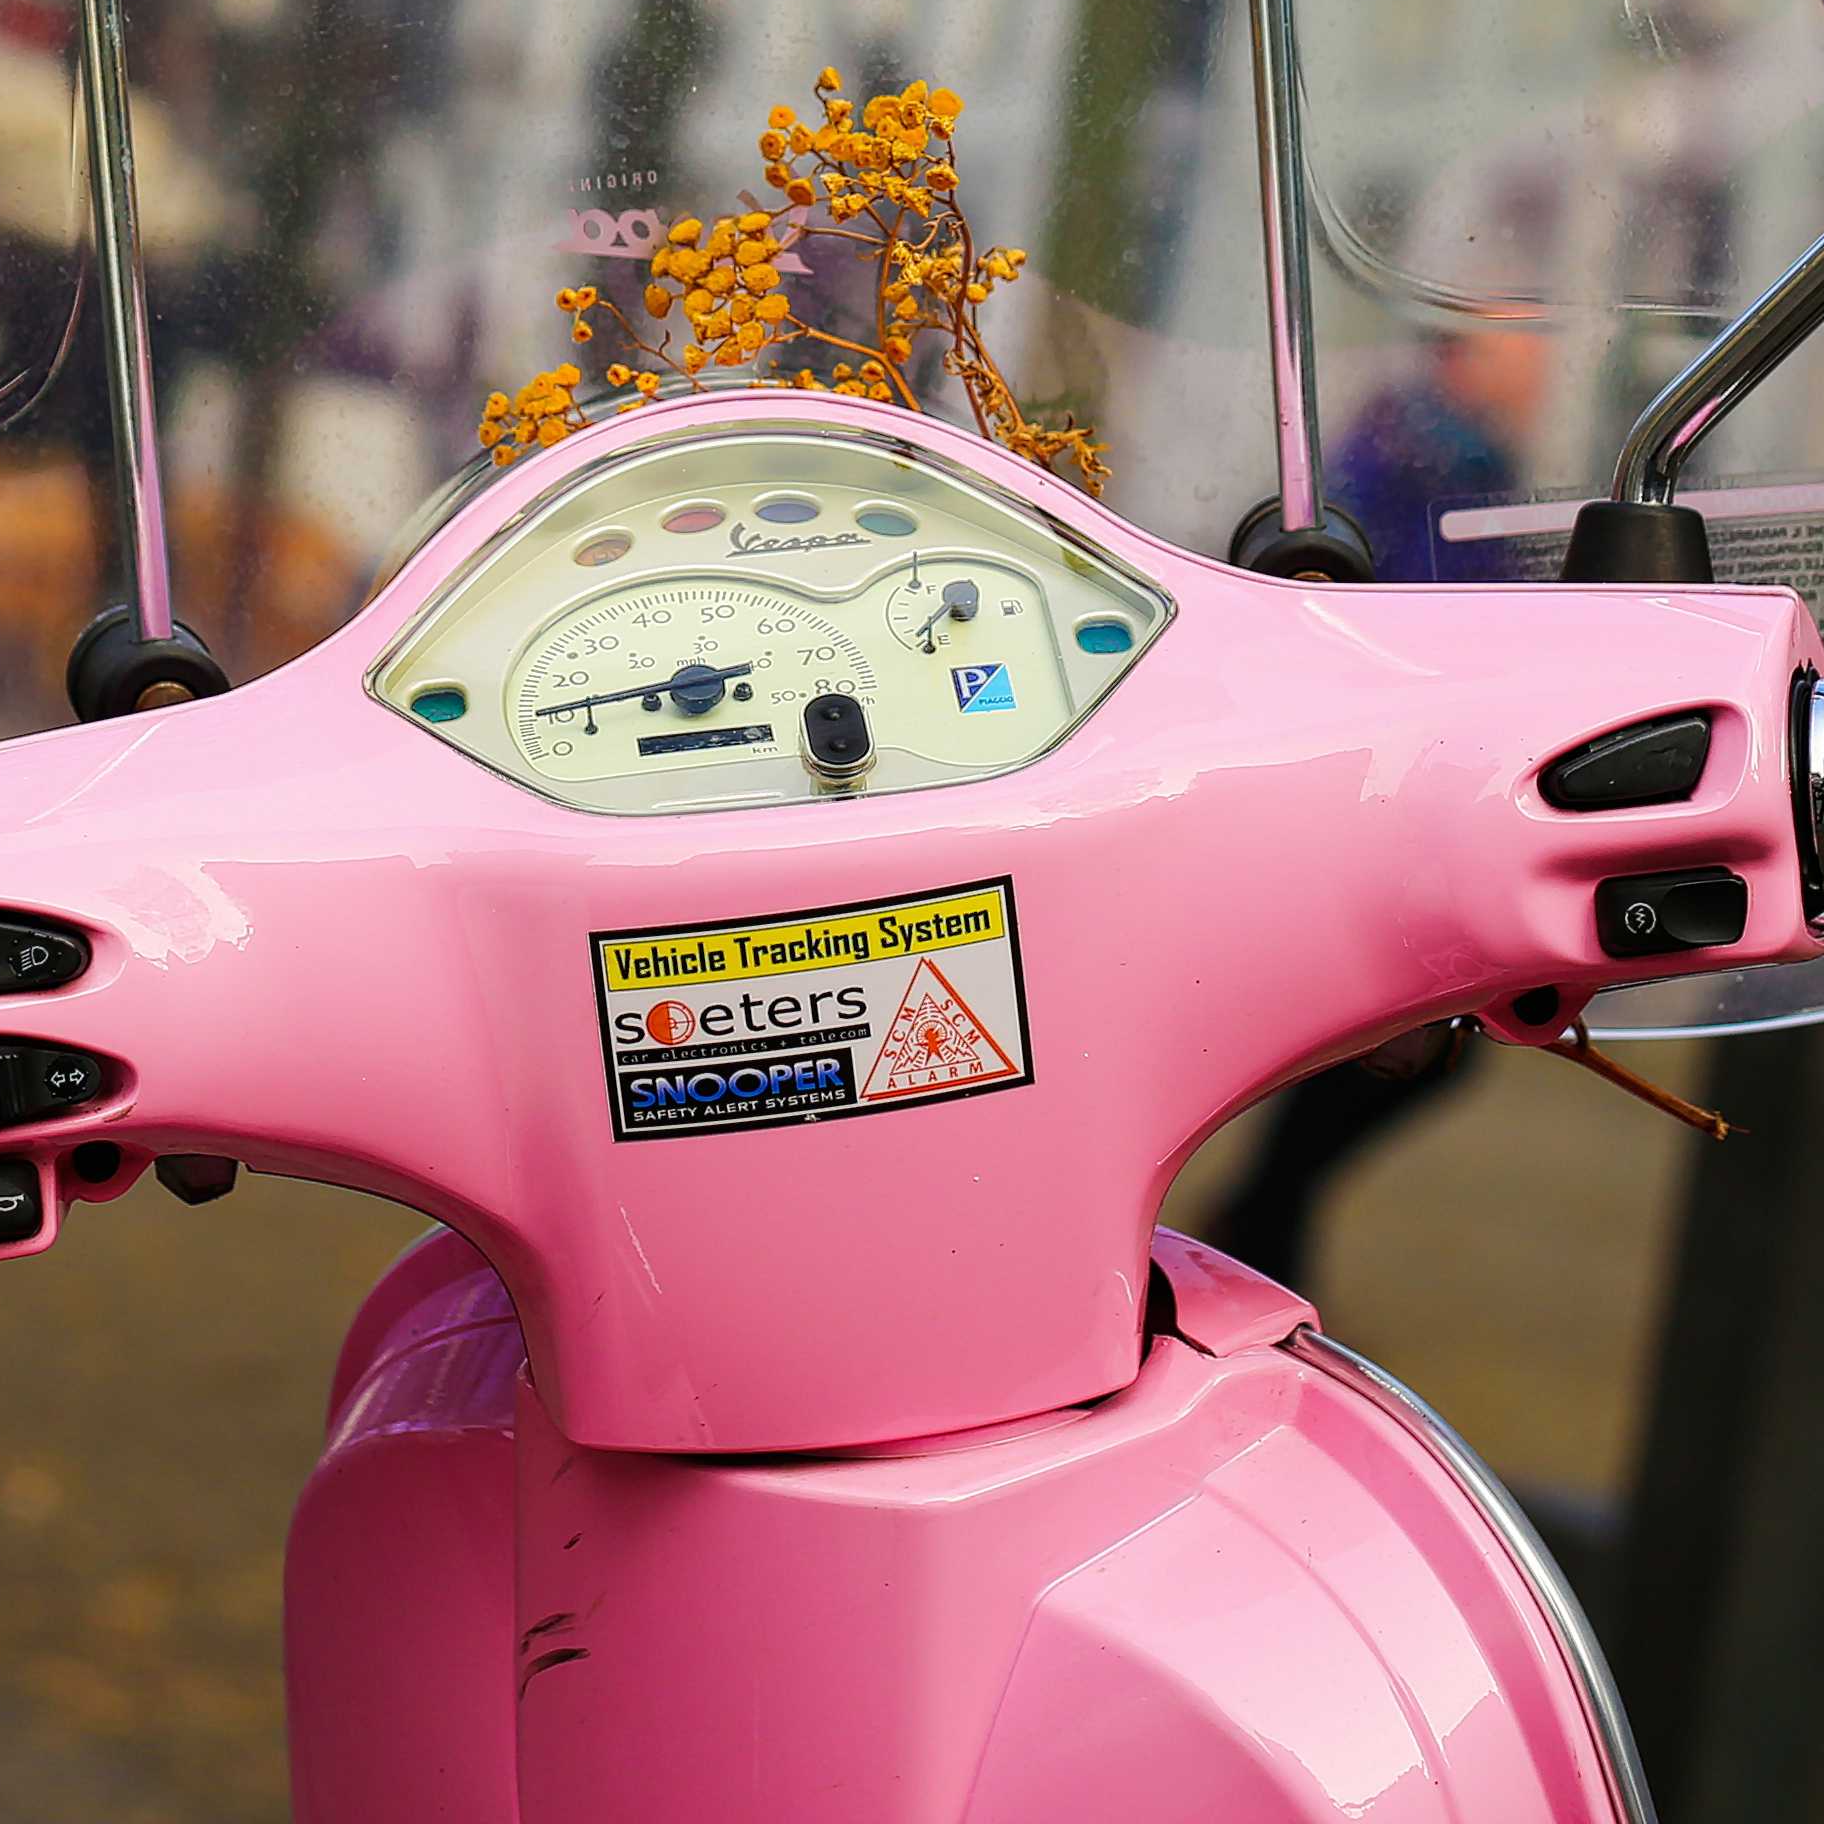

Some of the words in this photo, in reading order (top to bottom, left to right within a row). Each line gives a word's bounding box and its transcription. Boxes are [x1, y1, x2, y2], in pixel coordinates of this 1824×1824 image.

[726, 522, 872, 558] Vespa
[927, 584, 937, 594] F
[631, 610, 672, 628] 40
[700, 605, 735, 623] 50
[757, 618, 796, 635] 60
[583, 635, 619, 655] 30
[693, 640, 718, 655] 30
[937, 634, 951, 645] E
[628, 657, 655, 669] 20
[796, 646, 836, 665] 70
[552, 671, 589, 688] 20
[815, 678, 856, 695] 80
[771, 690, 796, 705] 50
[553, 741, 573, 756] 0
[752, 745, 778, 755] km
[614, 941, 726, 980] Vehicle
[733, 929, 869, 968] Tracking
[879, 907, 991, 951] System
[939, 998, 982, 1046] SCM
[621, 1053, 649, 1064] car
[661, 1040, 769, 1060] electronics
[800, 1027, 868, 1046] telecom
[630, 1057, 845, 1108] SNOOPER
[886, 1061, 984, 1089] ALARM
[634, 1107, 698, 1122] SAFETY
[704, 1100, 759, 1116] ALERT
[765, 1088, 847, 1109] SYSTEMS
